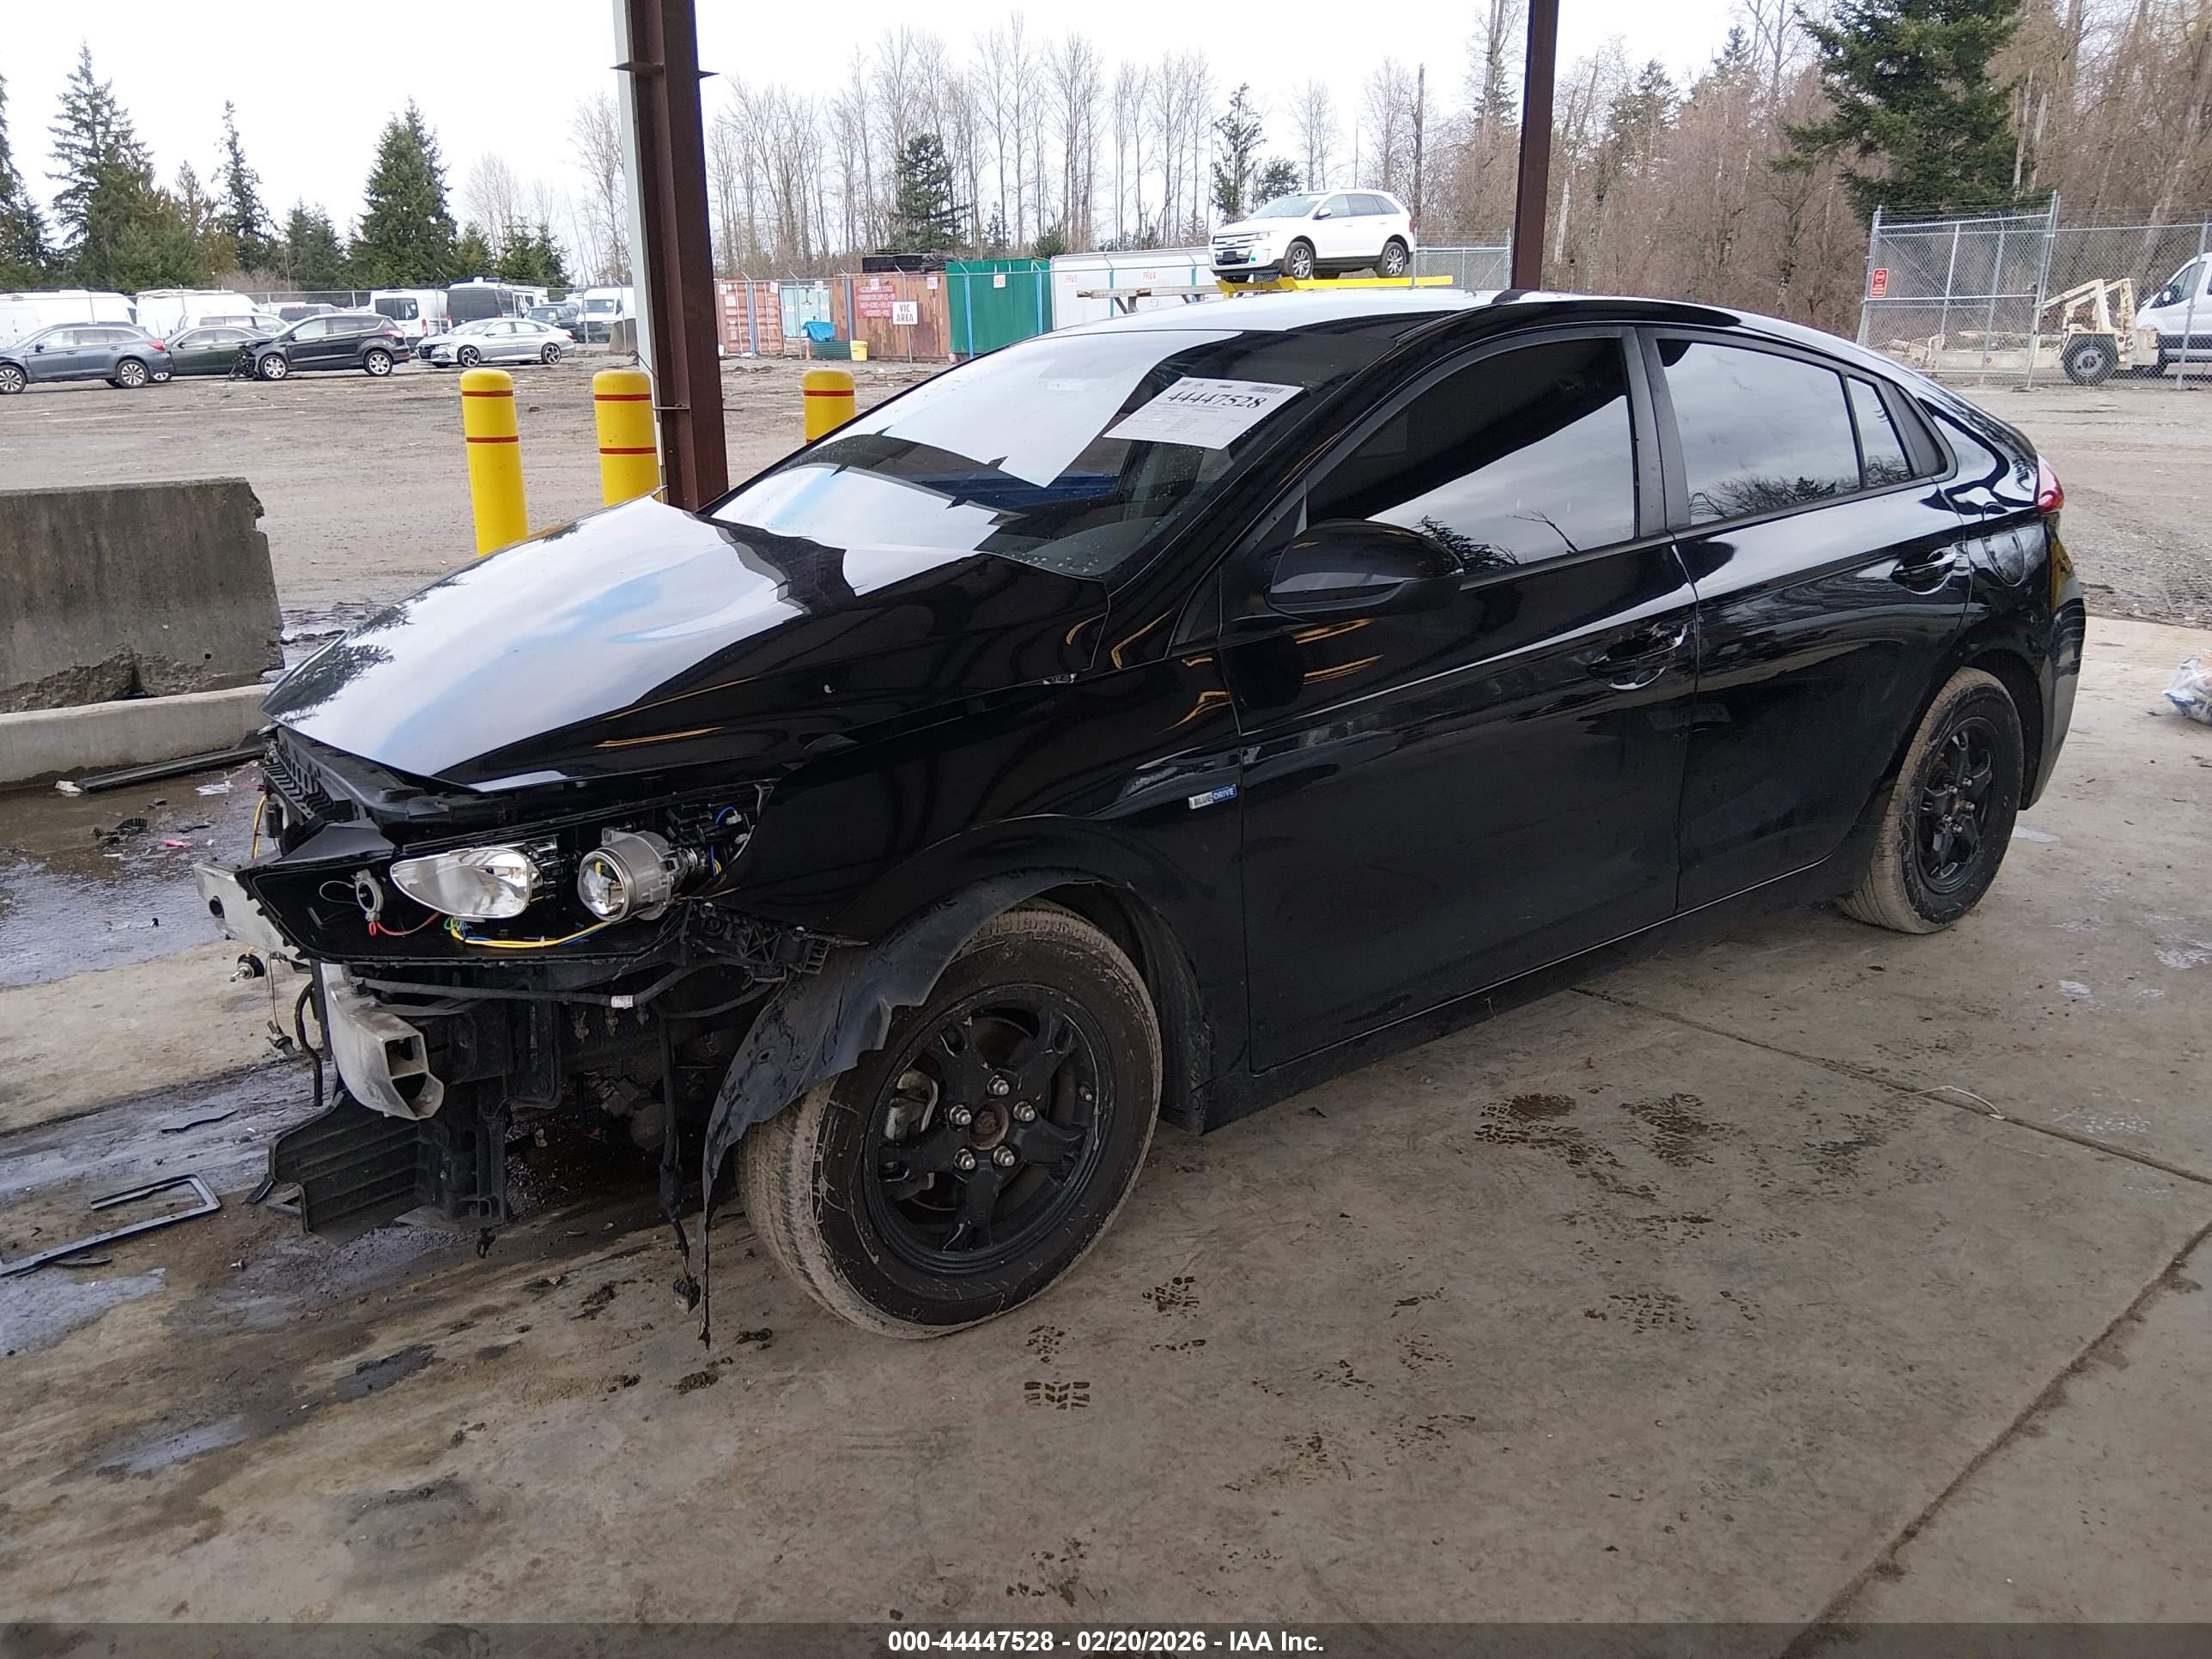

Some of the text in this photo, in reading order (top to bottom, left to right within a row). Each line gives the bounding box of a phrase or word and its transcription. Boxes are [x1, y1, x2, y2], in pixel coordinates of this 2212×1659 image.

[899, 303, 911, 313] VIC
[896, 313, 915, 322] AREA
[1168, 391, 1267, 409] 44447528
